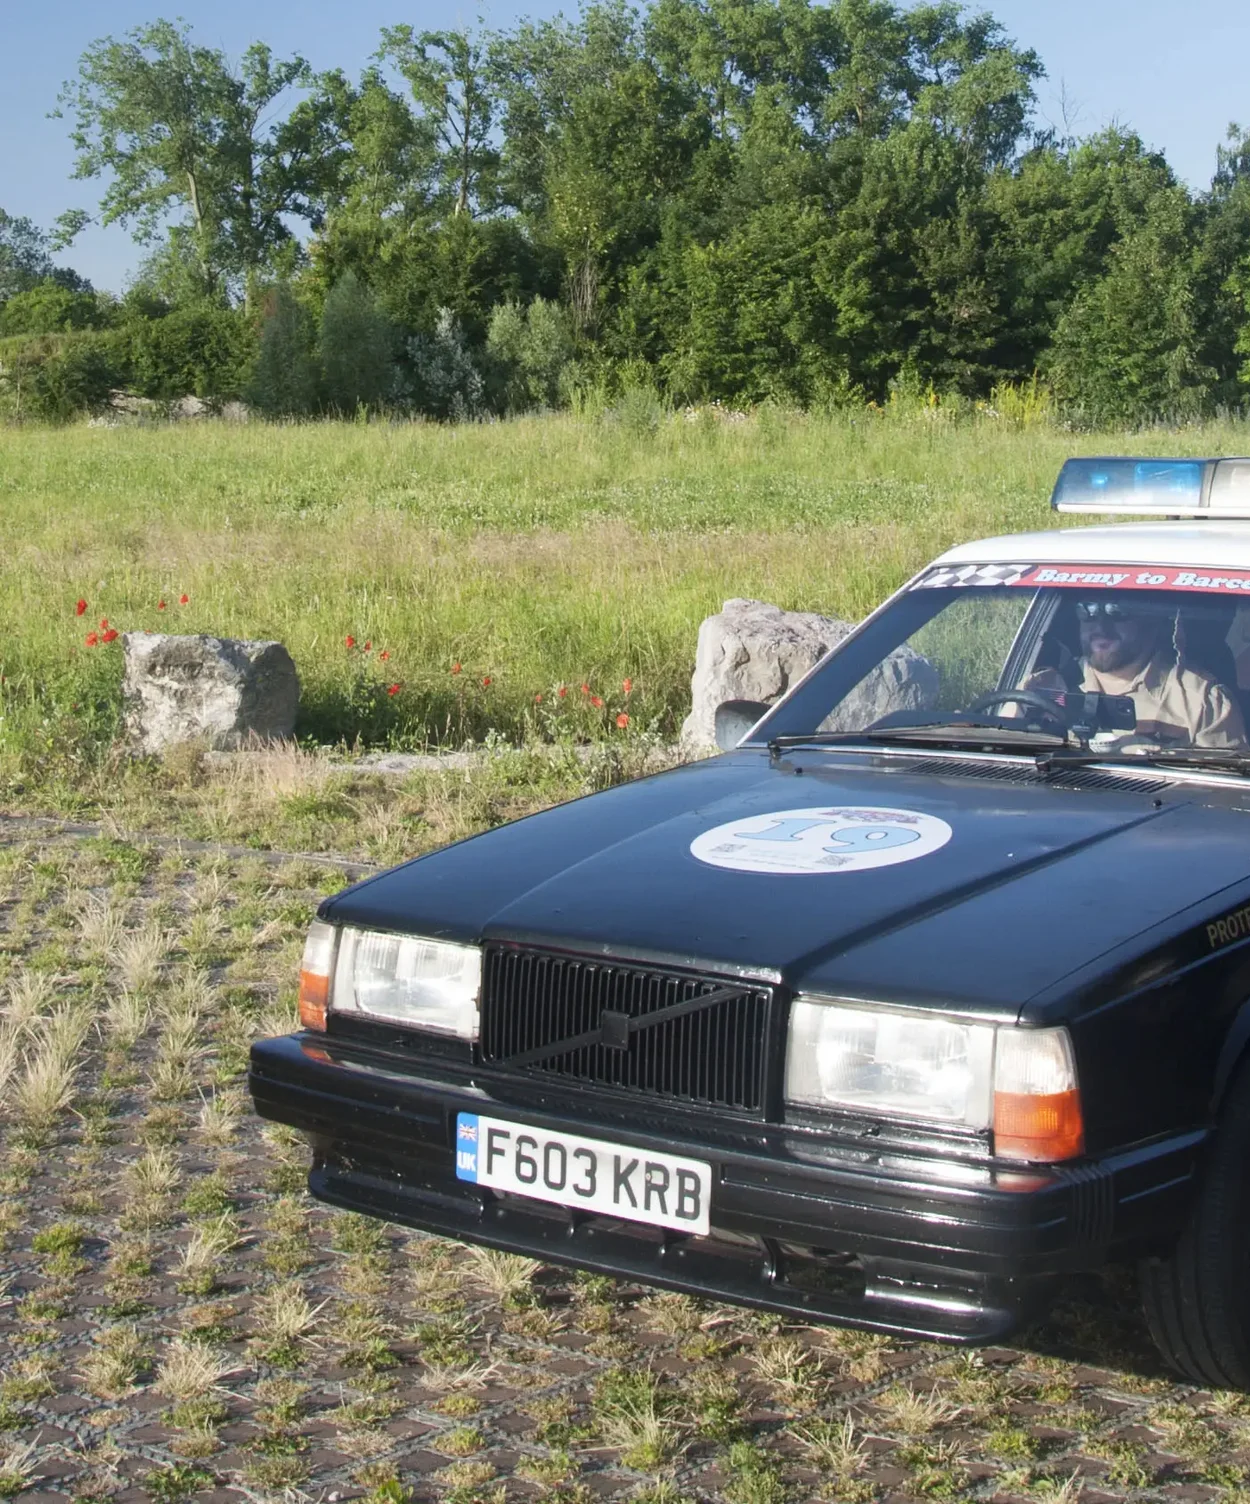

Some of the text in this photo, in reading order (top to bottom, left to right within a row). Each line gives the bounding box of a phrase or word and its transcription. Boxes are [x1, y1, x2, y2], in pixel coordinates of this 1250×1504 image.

[1033, 569, 1130, 586] Barmy
[1135, 572, 1167, 585] to
[734, 818, 921, 853] 19
[457, 1151, 476, 1173] UK
[486, 1127, 701, 1221] F603 KRB
